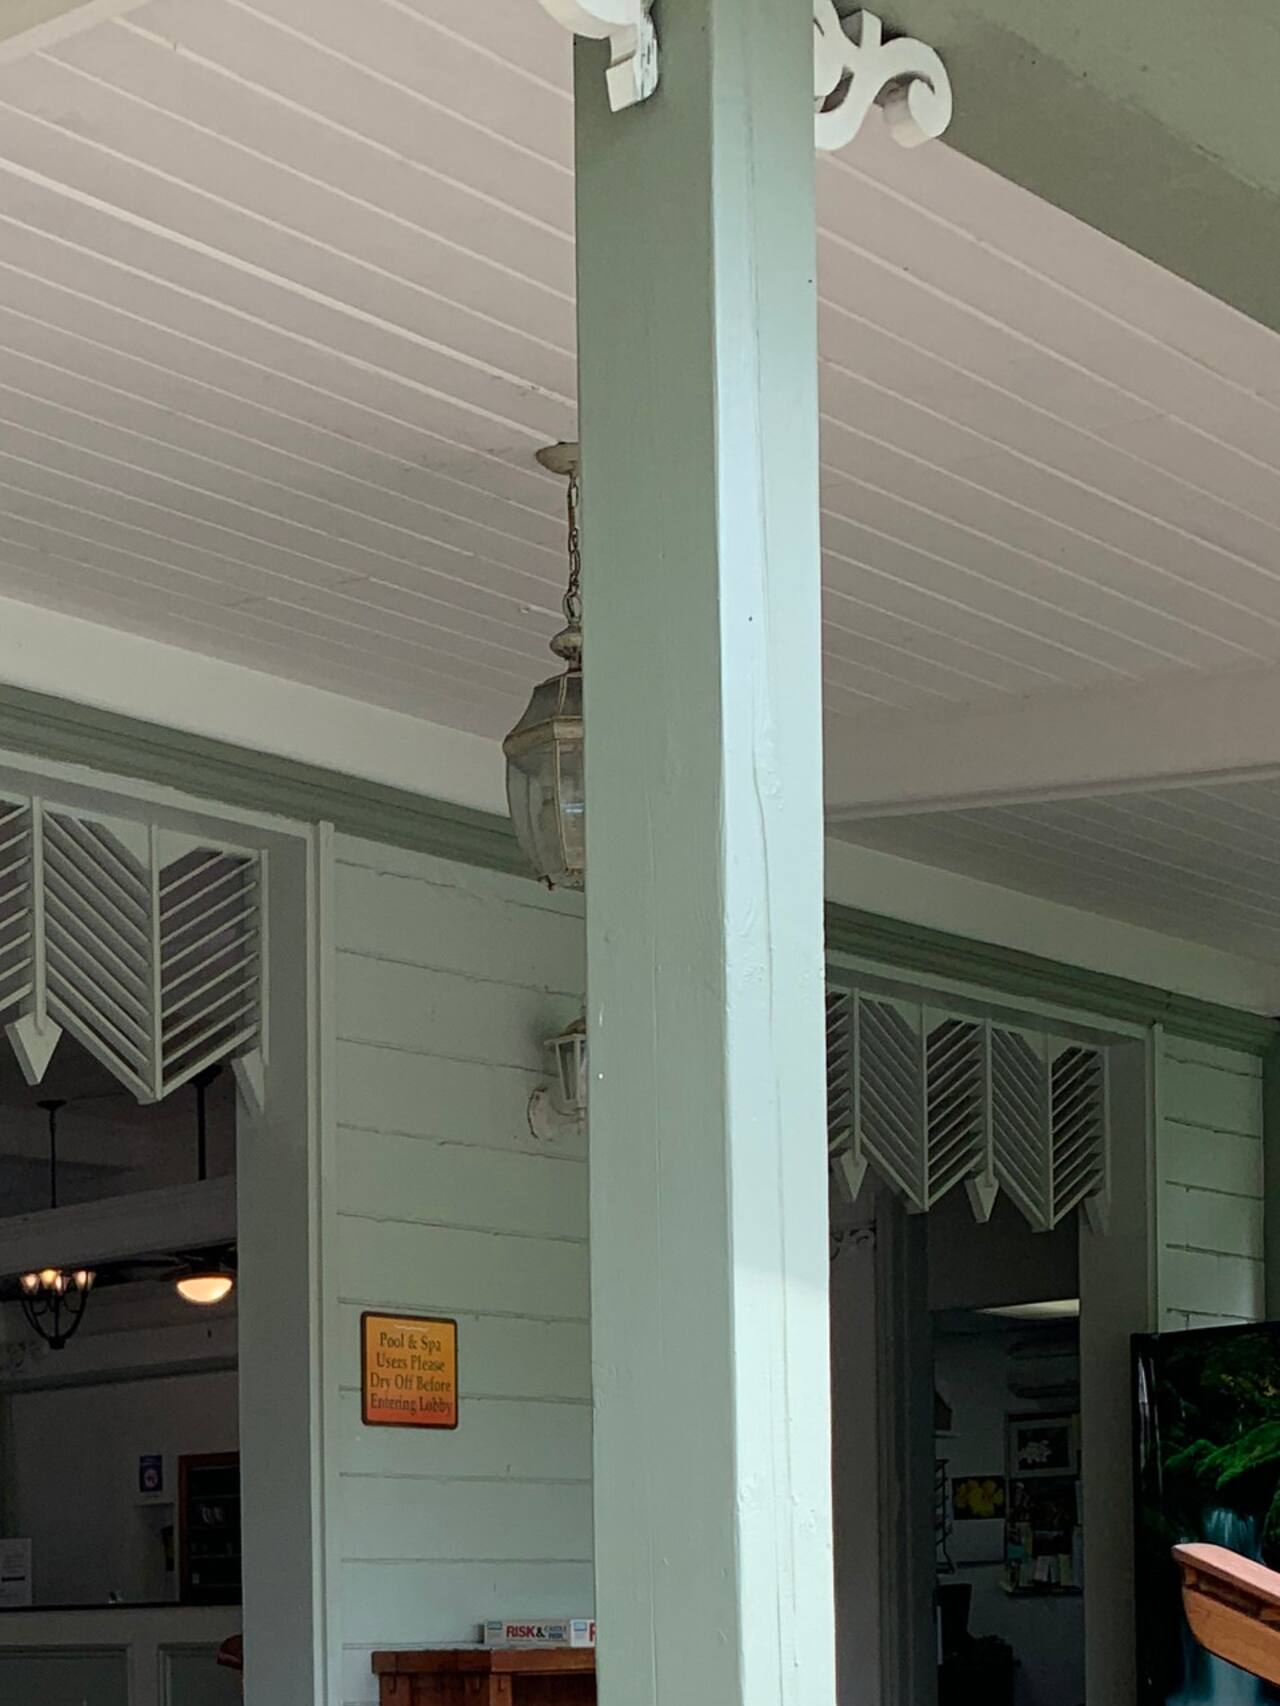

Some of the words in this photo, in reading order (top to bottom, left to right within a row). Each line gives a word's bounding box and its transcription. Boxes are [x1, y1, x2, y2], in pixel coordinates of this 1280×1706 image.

[380, 1332, 404, 1348] Pool
[408, 1334, 417, 1350] &
[421, 1335, 441, 1355] Spa
[376, 1352, 407, 1369] Users
[410, 1355, 445, 1372] Please
[370, 1372, 390, 1391] Dry
[395, 1374, 413, 1390] Off
[416, 1376, 451, 1392] Before
[370, 1393, 417, 1415] Entering
[419, 1396, 452, 1417] Lobby
[506, 1625, 535, 1638] RISK
[536, 1627, 545, 1638] &
